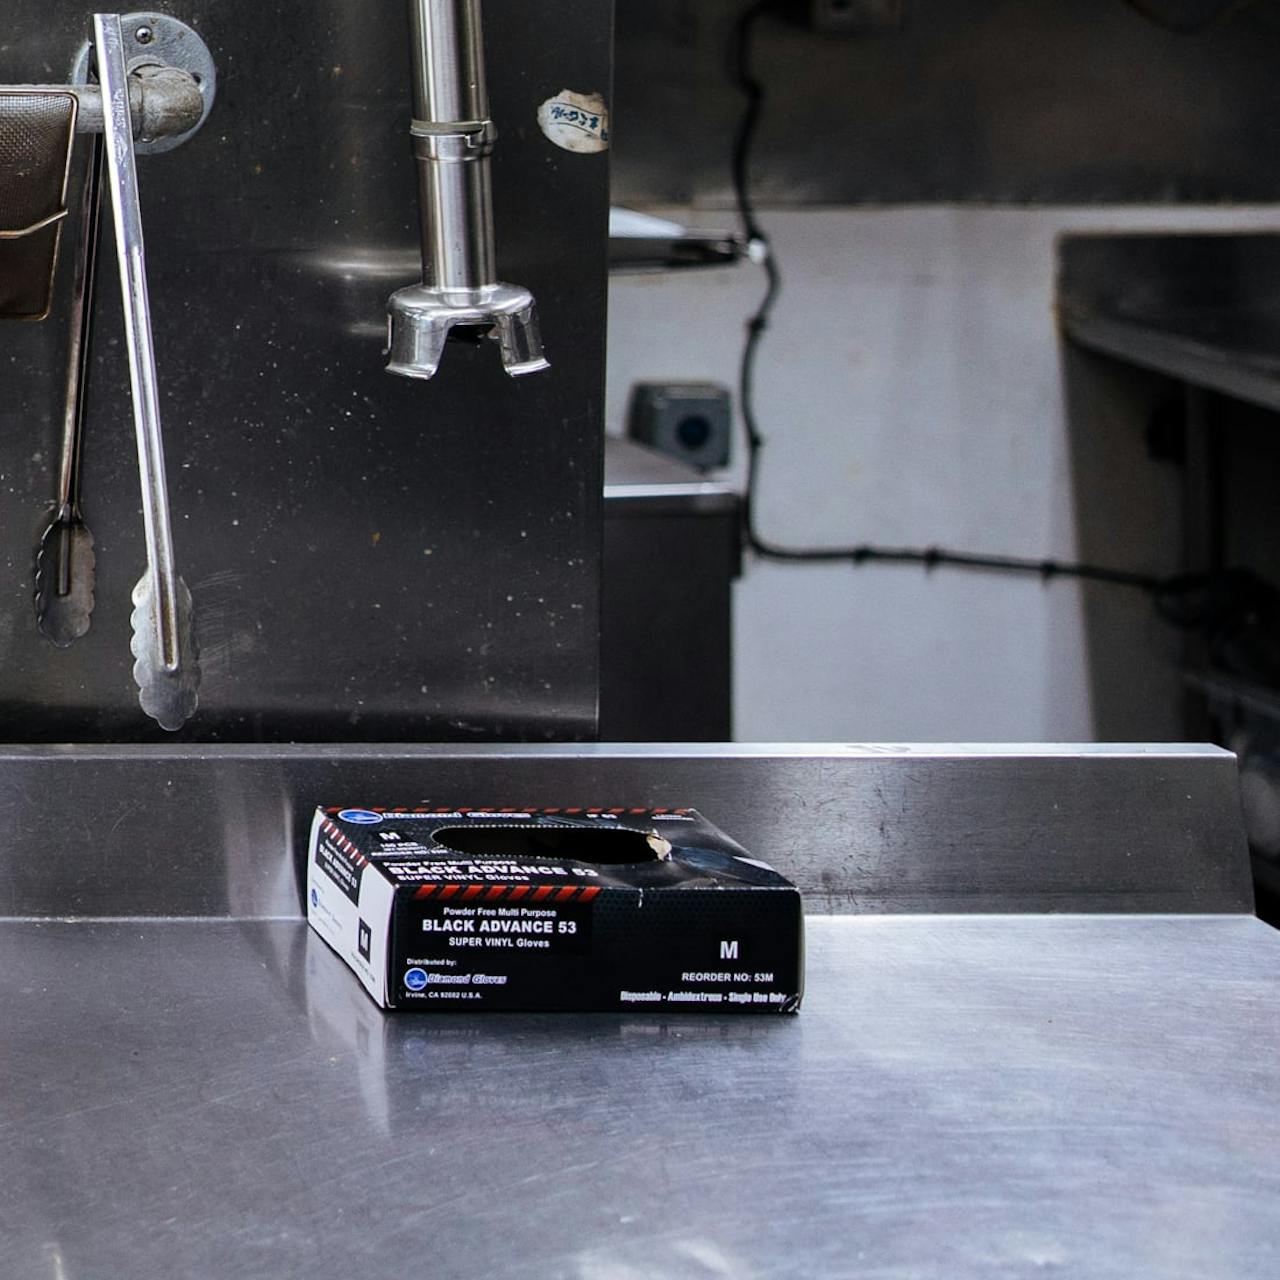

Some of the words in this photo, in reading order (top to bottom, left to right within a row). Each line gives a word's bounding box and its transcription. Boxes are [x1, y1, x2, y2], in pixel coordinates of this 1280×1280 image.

[388, 866, 462, 875] BLACK
[468, 866, 569, 876] ADVANCE
[572, 868, 599, 877] 53
[443, 907, 475, 917] Powder
[477, 907, 496, 917] Free
[498, 907, 519, 917] Multi
[521, 908, 557, 919] Purpose
[422, 919, 475, 933] BLACK
[479, 920, 553, 934] ADVANCE
[558, 921, 577, 934] 53
[448, 936, 482, 947] SUPER
[484, 937, 514, 947] VINYL
[516, 937, 550, 948] Gloves
[720, 940, 738, 959] M
[406, 957, 445, 966] Distributed
[427, 972, 471, 984] Diamond
[471, 973, 507, 985] Gloves
[681, 972, 731, 982] REORDER
[733, 973, 752, 982] NO:
[754, 973, 774, 982] 53M
[620, 991, 661, 1002] Disposable
[667, 991, 722, 1002] Ambidextrous
[728, 992, 752, 1004] Single
